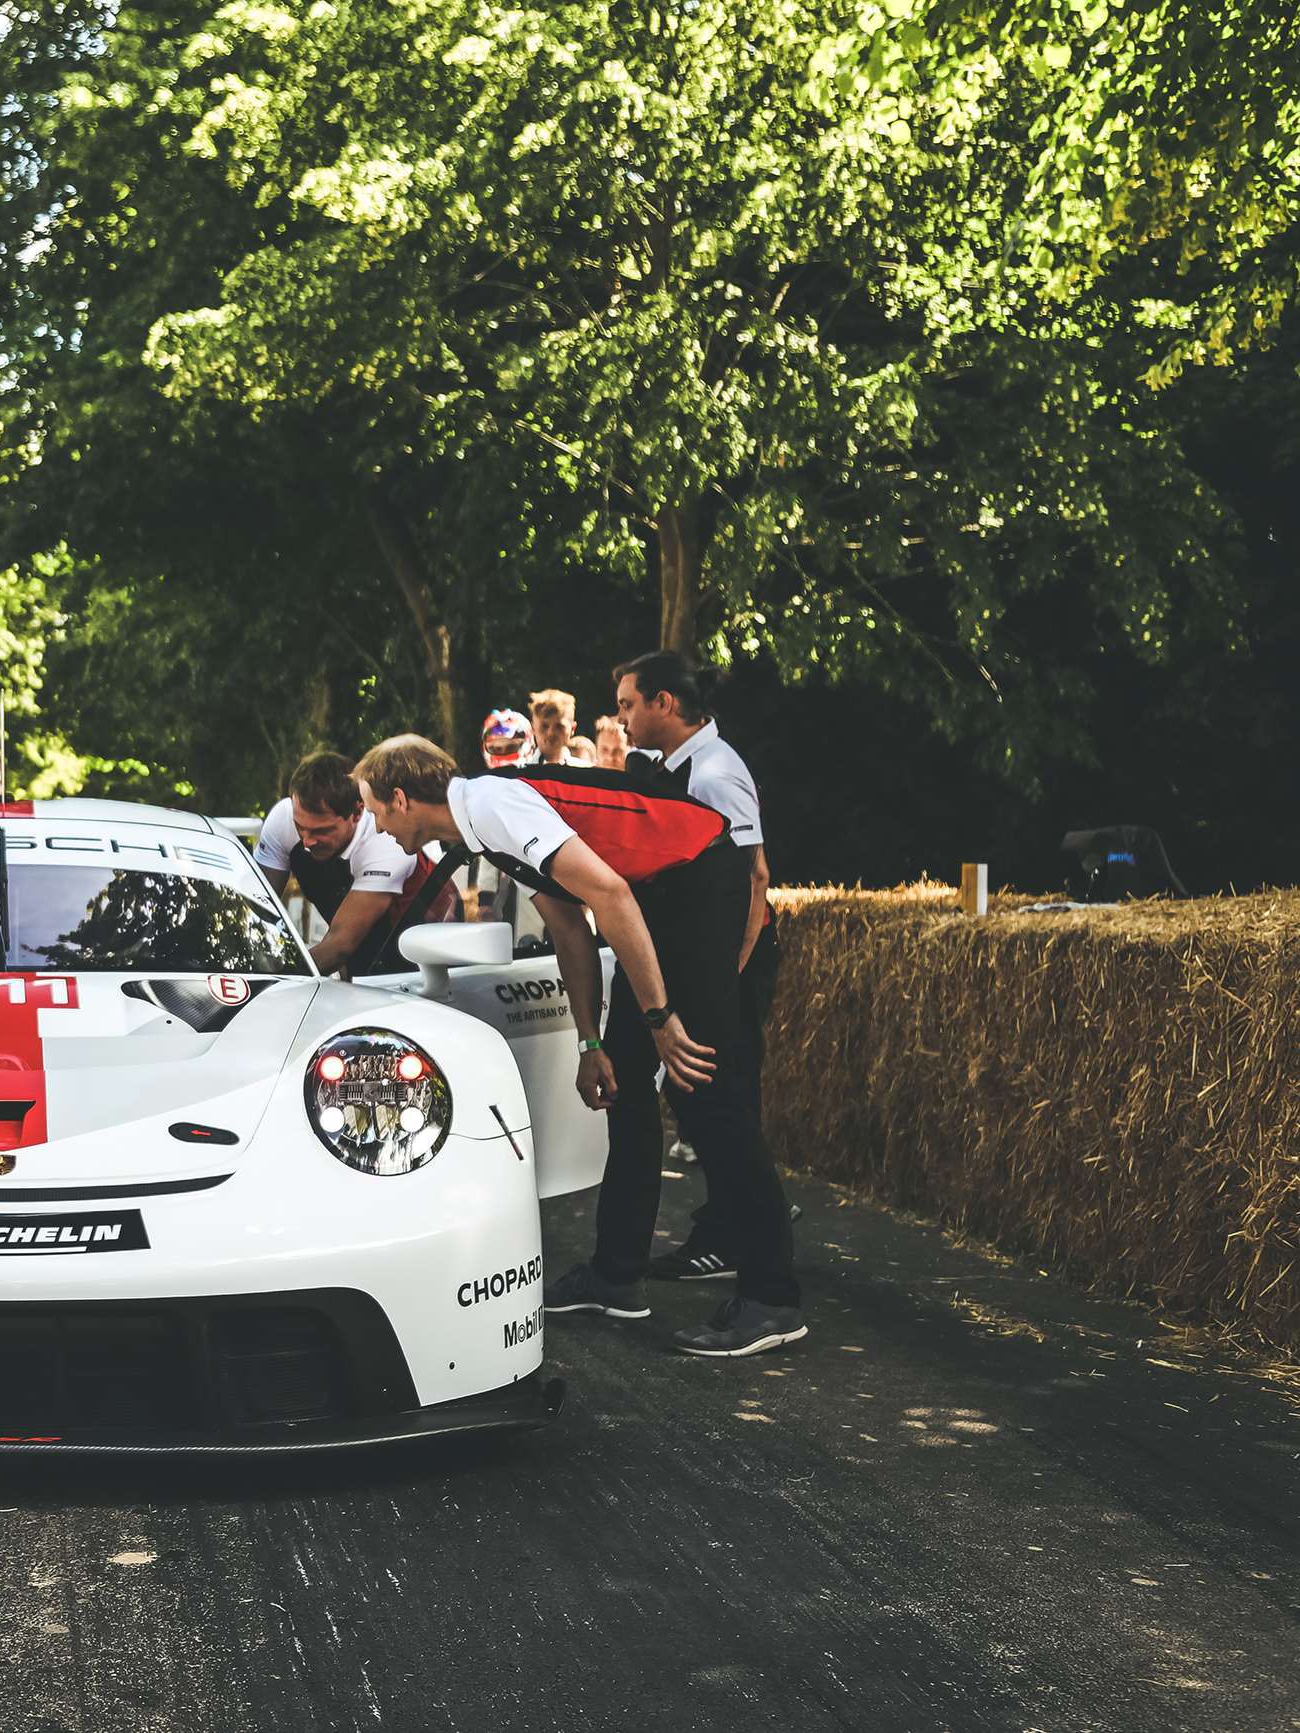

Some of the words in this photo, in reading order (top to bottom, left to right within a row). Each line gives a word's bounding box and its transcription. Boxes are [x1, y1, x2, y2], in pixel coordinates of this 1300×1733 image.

[220, 978, 239, 999] E
[495, 978, 566, 1004] CHOPA
[506, 1012, 523, 1024] THE
[524, 1007, 558, 1020] ARTISAN
[558, 1005, 569, 1017] OF
[457, 1254, 542, 1308] CHOPARD
[503, 1310, 537, 1349] Mobil
